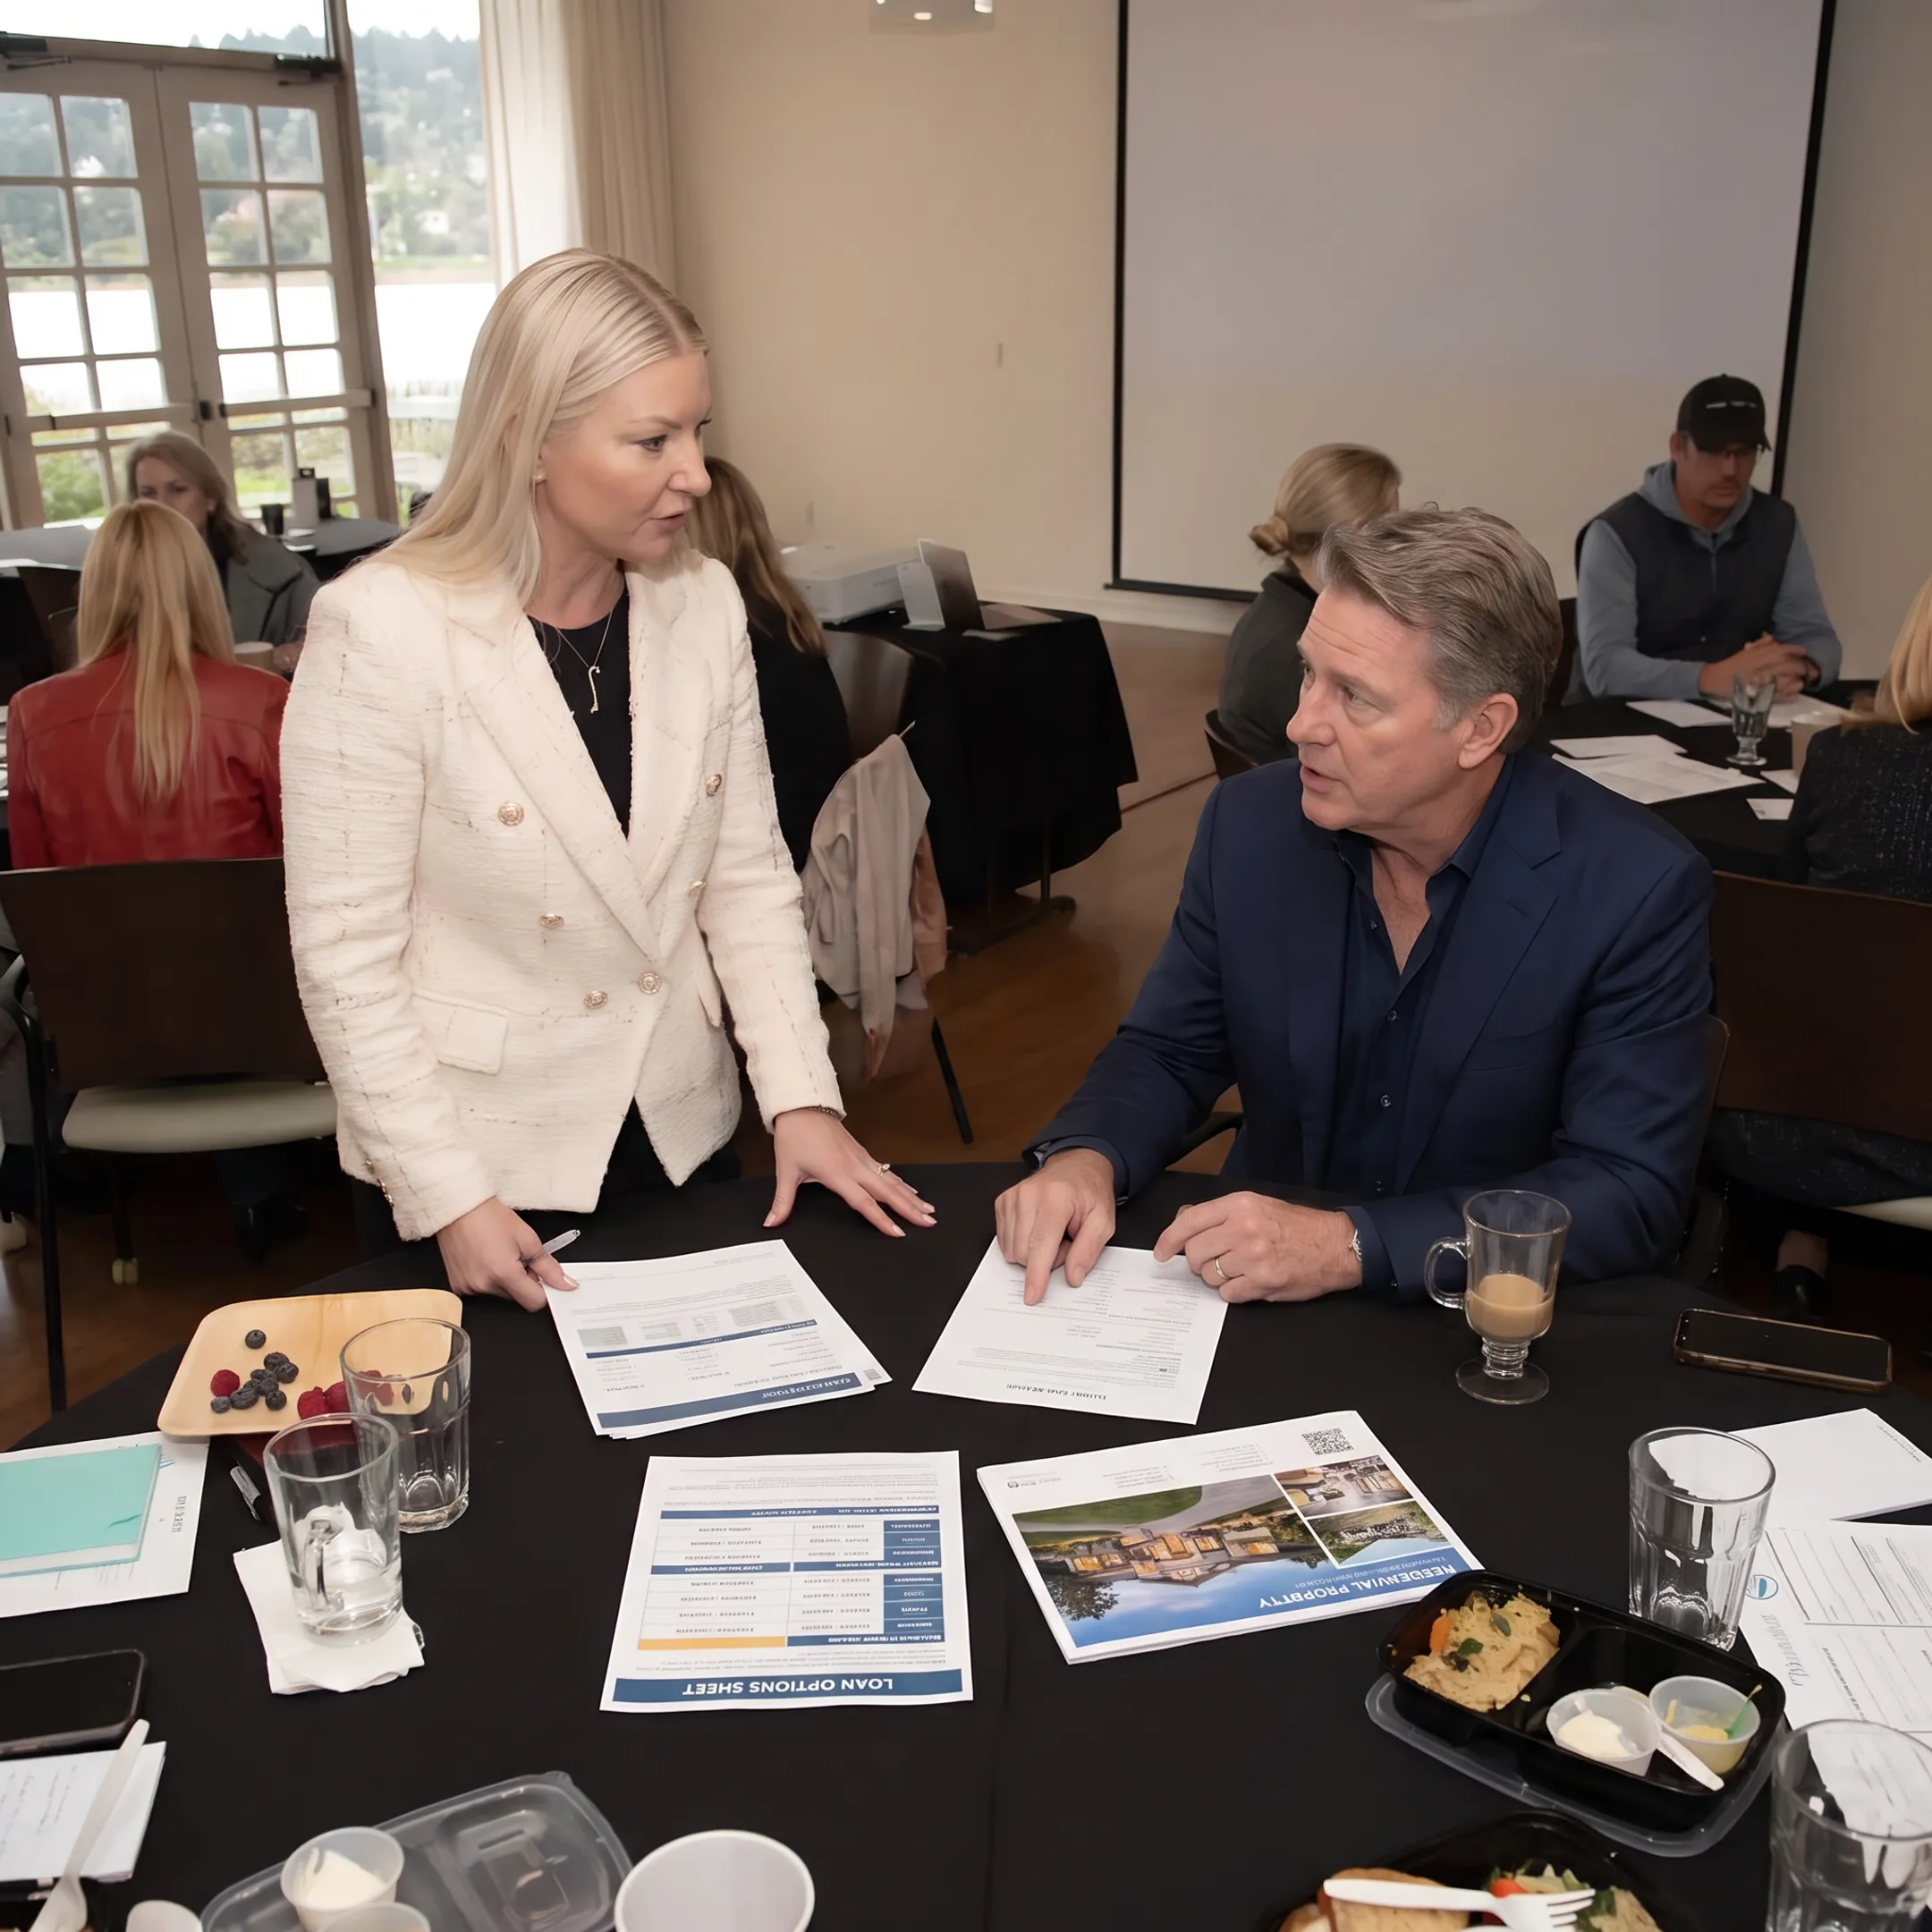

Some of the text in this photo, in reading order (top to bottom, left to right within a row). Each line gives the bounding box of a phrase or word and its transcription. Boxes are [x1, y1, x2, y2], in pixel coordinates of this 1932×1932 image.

[682, 1678, 893, 1695] LOAN OPTIONS SHEET
